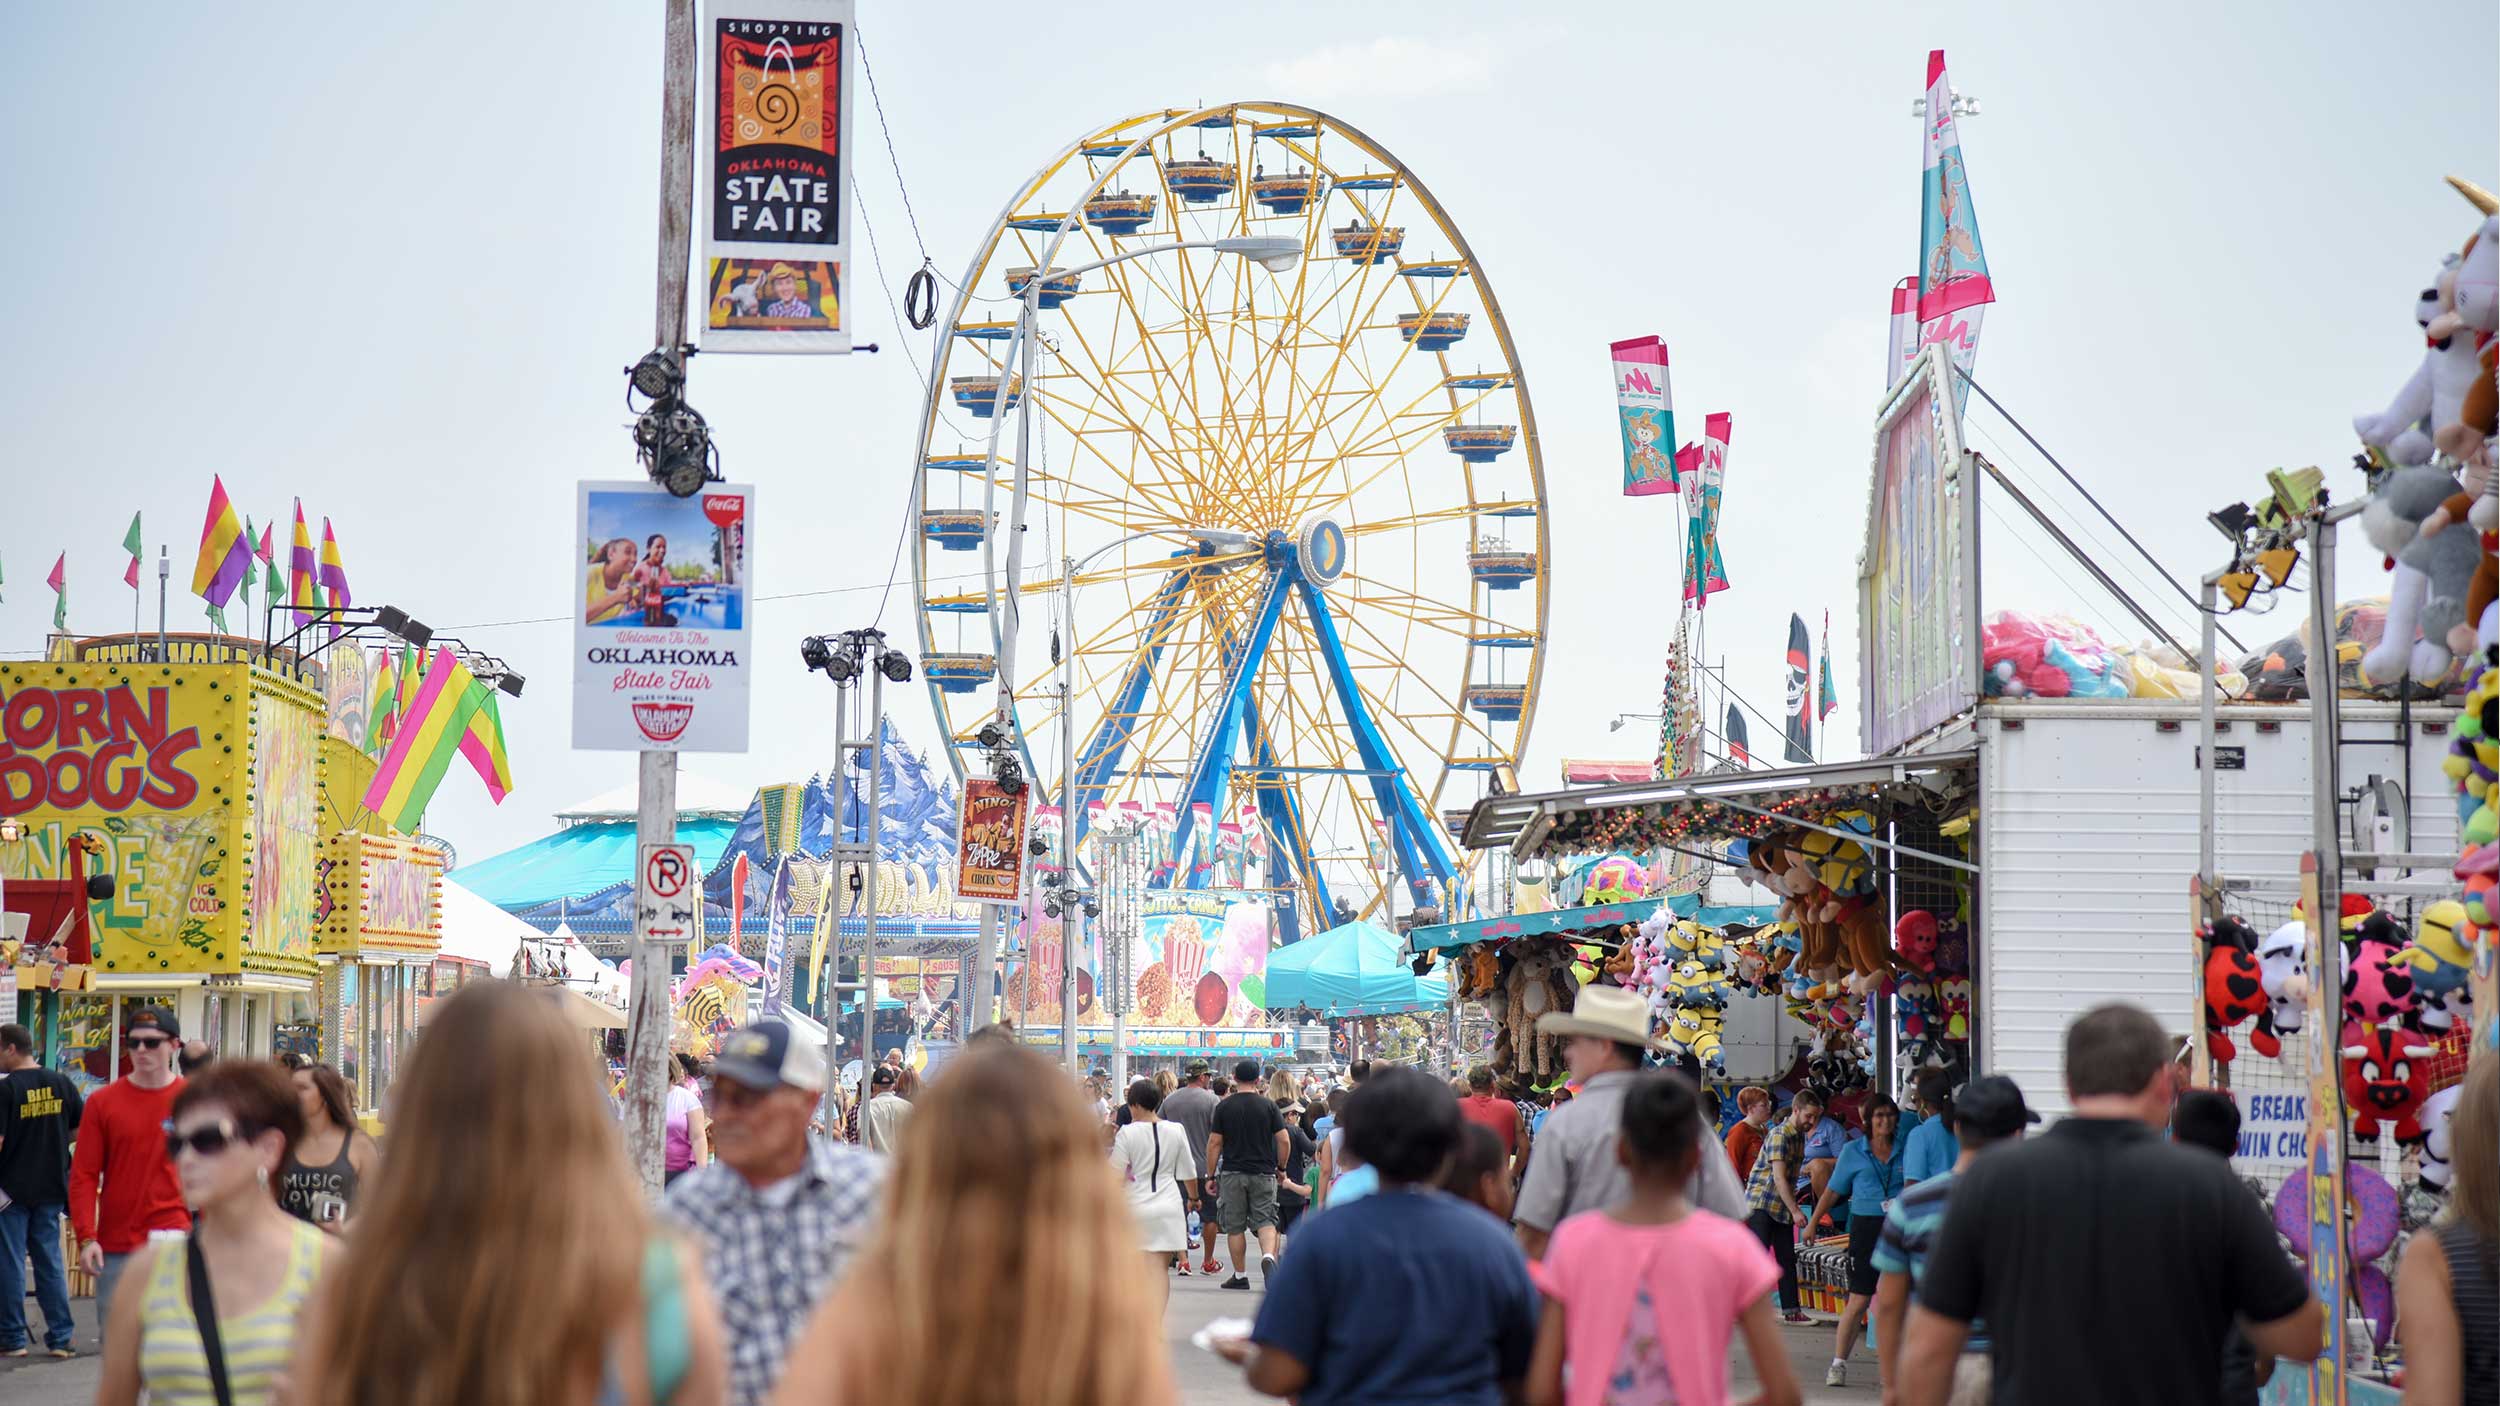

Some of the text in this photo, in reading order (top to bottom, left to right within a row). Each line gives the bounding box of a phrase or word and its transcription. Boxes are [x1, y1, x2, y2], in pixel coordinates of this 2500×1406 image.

[728, 22, 831, 36] SHOPPING
[727, 157, 826, 177] OKLAHOMA
[725, 174, 829, 203] STATE
[731, 205, 823, 233] FAIR
[616, 630, 709, 645] Welcome To The
[588, 648, 738, 666] OKLAHOMA
[613, 668, 713, 692] State Fair
[0, 684, 169, 755] ORN
[0, 727, 200, 817] DOGS
[971, 874, 995, 885] CIRCUS
[189, 897, 220, 913] COLD
[2250, 1095, 2305, 1121] BREAK
[2237, 1131, 2271, 1158] WIN
[283, 1173, 342, 1190] MUSIC
